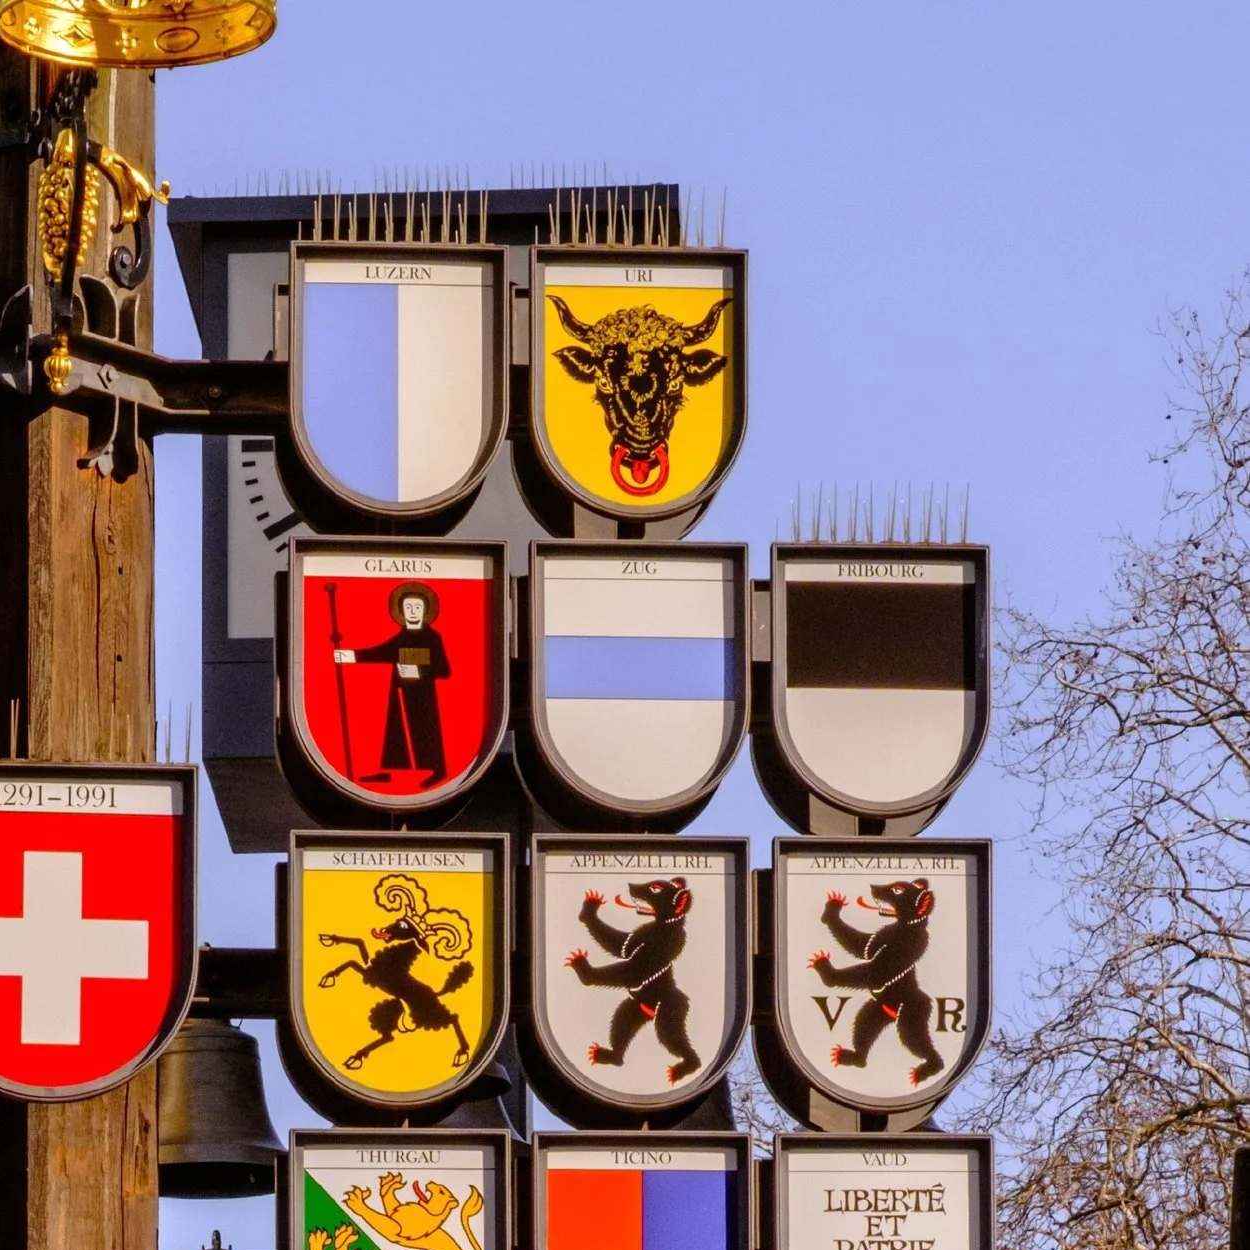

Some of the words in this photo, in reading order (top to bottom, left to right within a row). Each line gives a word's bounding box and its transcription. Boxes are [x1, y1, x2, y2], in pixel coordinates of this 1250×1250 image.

[365, 266, 432, 280] LUZERN
[625, 269, 653, 283] URI
[364, 559, 432, 573] GLARUS
[621, 561, 657, 575] ZUG
[837, 564, 924, 578] FRIBOURG
[332, 852, 466, 867] SCHAFFHAUSEN
[570, 855, 668, 868] APPENZELL
[685, 856, 712, 869] RH.
[810, 856, 908, 869] APPENZELL
[913, 857, 928, 870] A.
[932, 858, 959, 870] RH.
[810, 996, 852, 1032] V
[935, 997, 967, 1032] R
[356, 1150, 442, 1164] THURGAU
[611, 1151, 672, 1164] TICINO
[862, 1153, 907, 1167] VAUD
[823, 1182, 946, 1215] LIBERTÉ
[864, 1214, 907, 1238] ET
